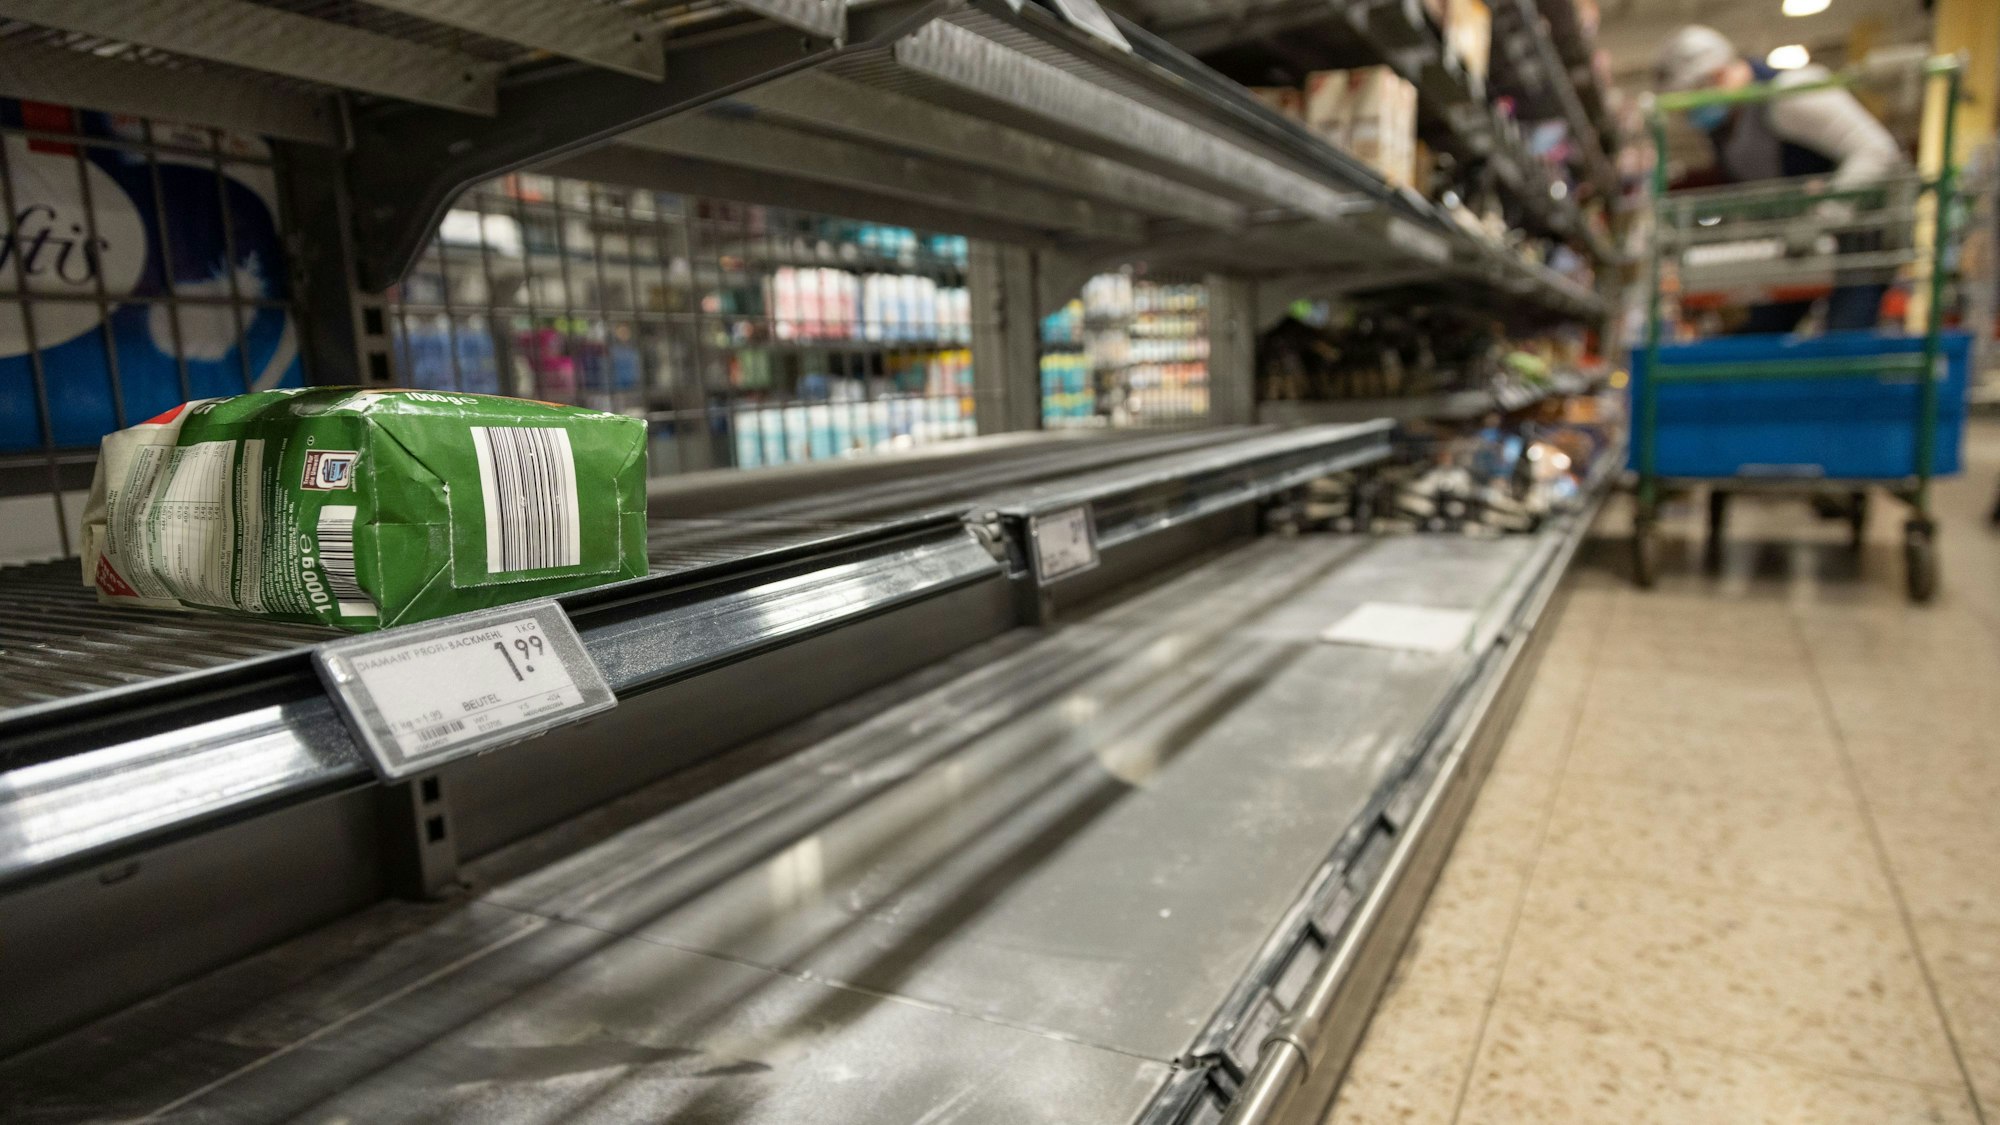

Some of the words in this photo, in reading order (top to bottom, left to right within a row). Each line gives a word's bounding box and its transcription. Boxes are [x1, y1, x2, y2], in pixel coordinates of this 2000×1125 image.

[405, 392, 448, 403] 1000
[303, 463, 312, 485] Trennen
[310, 454, 319, 476] Umwelt
[301, 556, 315, 569] g
[301, 571, 332, 614] 1000
[357, 651, 412, 673] DIAMANT
[414, 630, 503, 657] PROFI-BACKMEHL
[461, 693, 502, 712] BEUTEL
